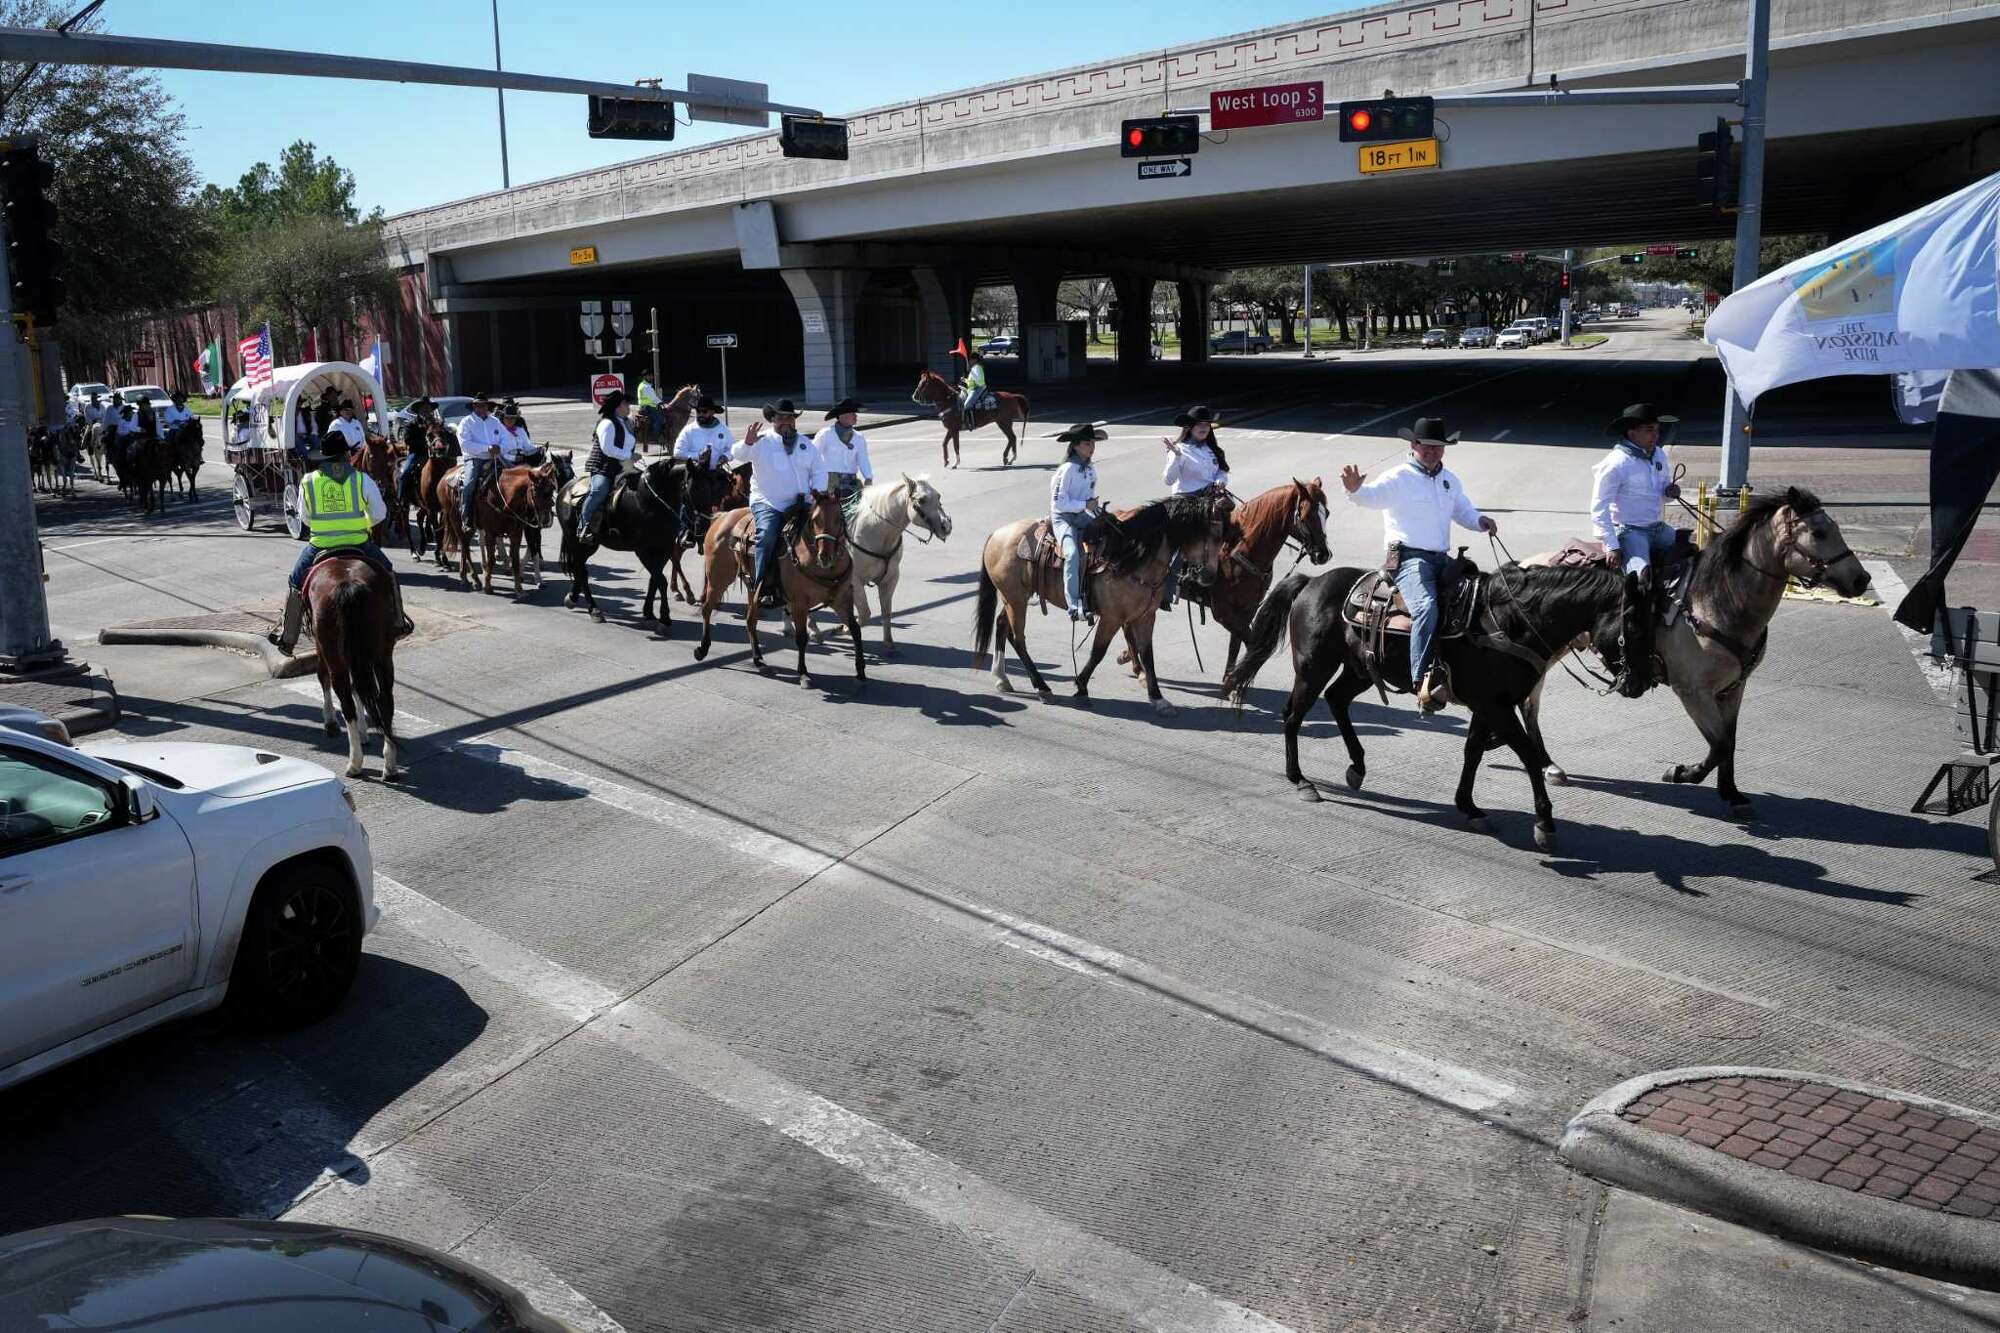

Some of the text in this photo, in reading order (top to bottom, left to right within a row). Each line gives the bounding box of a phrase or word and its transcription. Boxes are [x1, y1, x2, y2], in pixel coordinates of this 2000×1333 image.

[1218, 87, 1317, 111] West Loop S
[1295, 107, 1317, 117] 6300
[1143, 164, 1175, 174] ONE WAY
